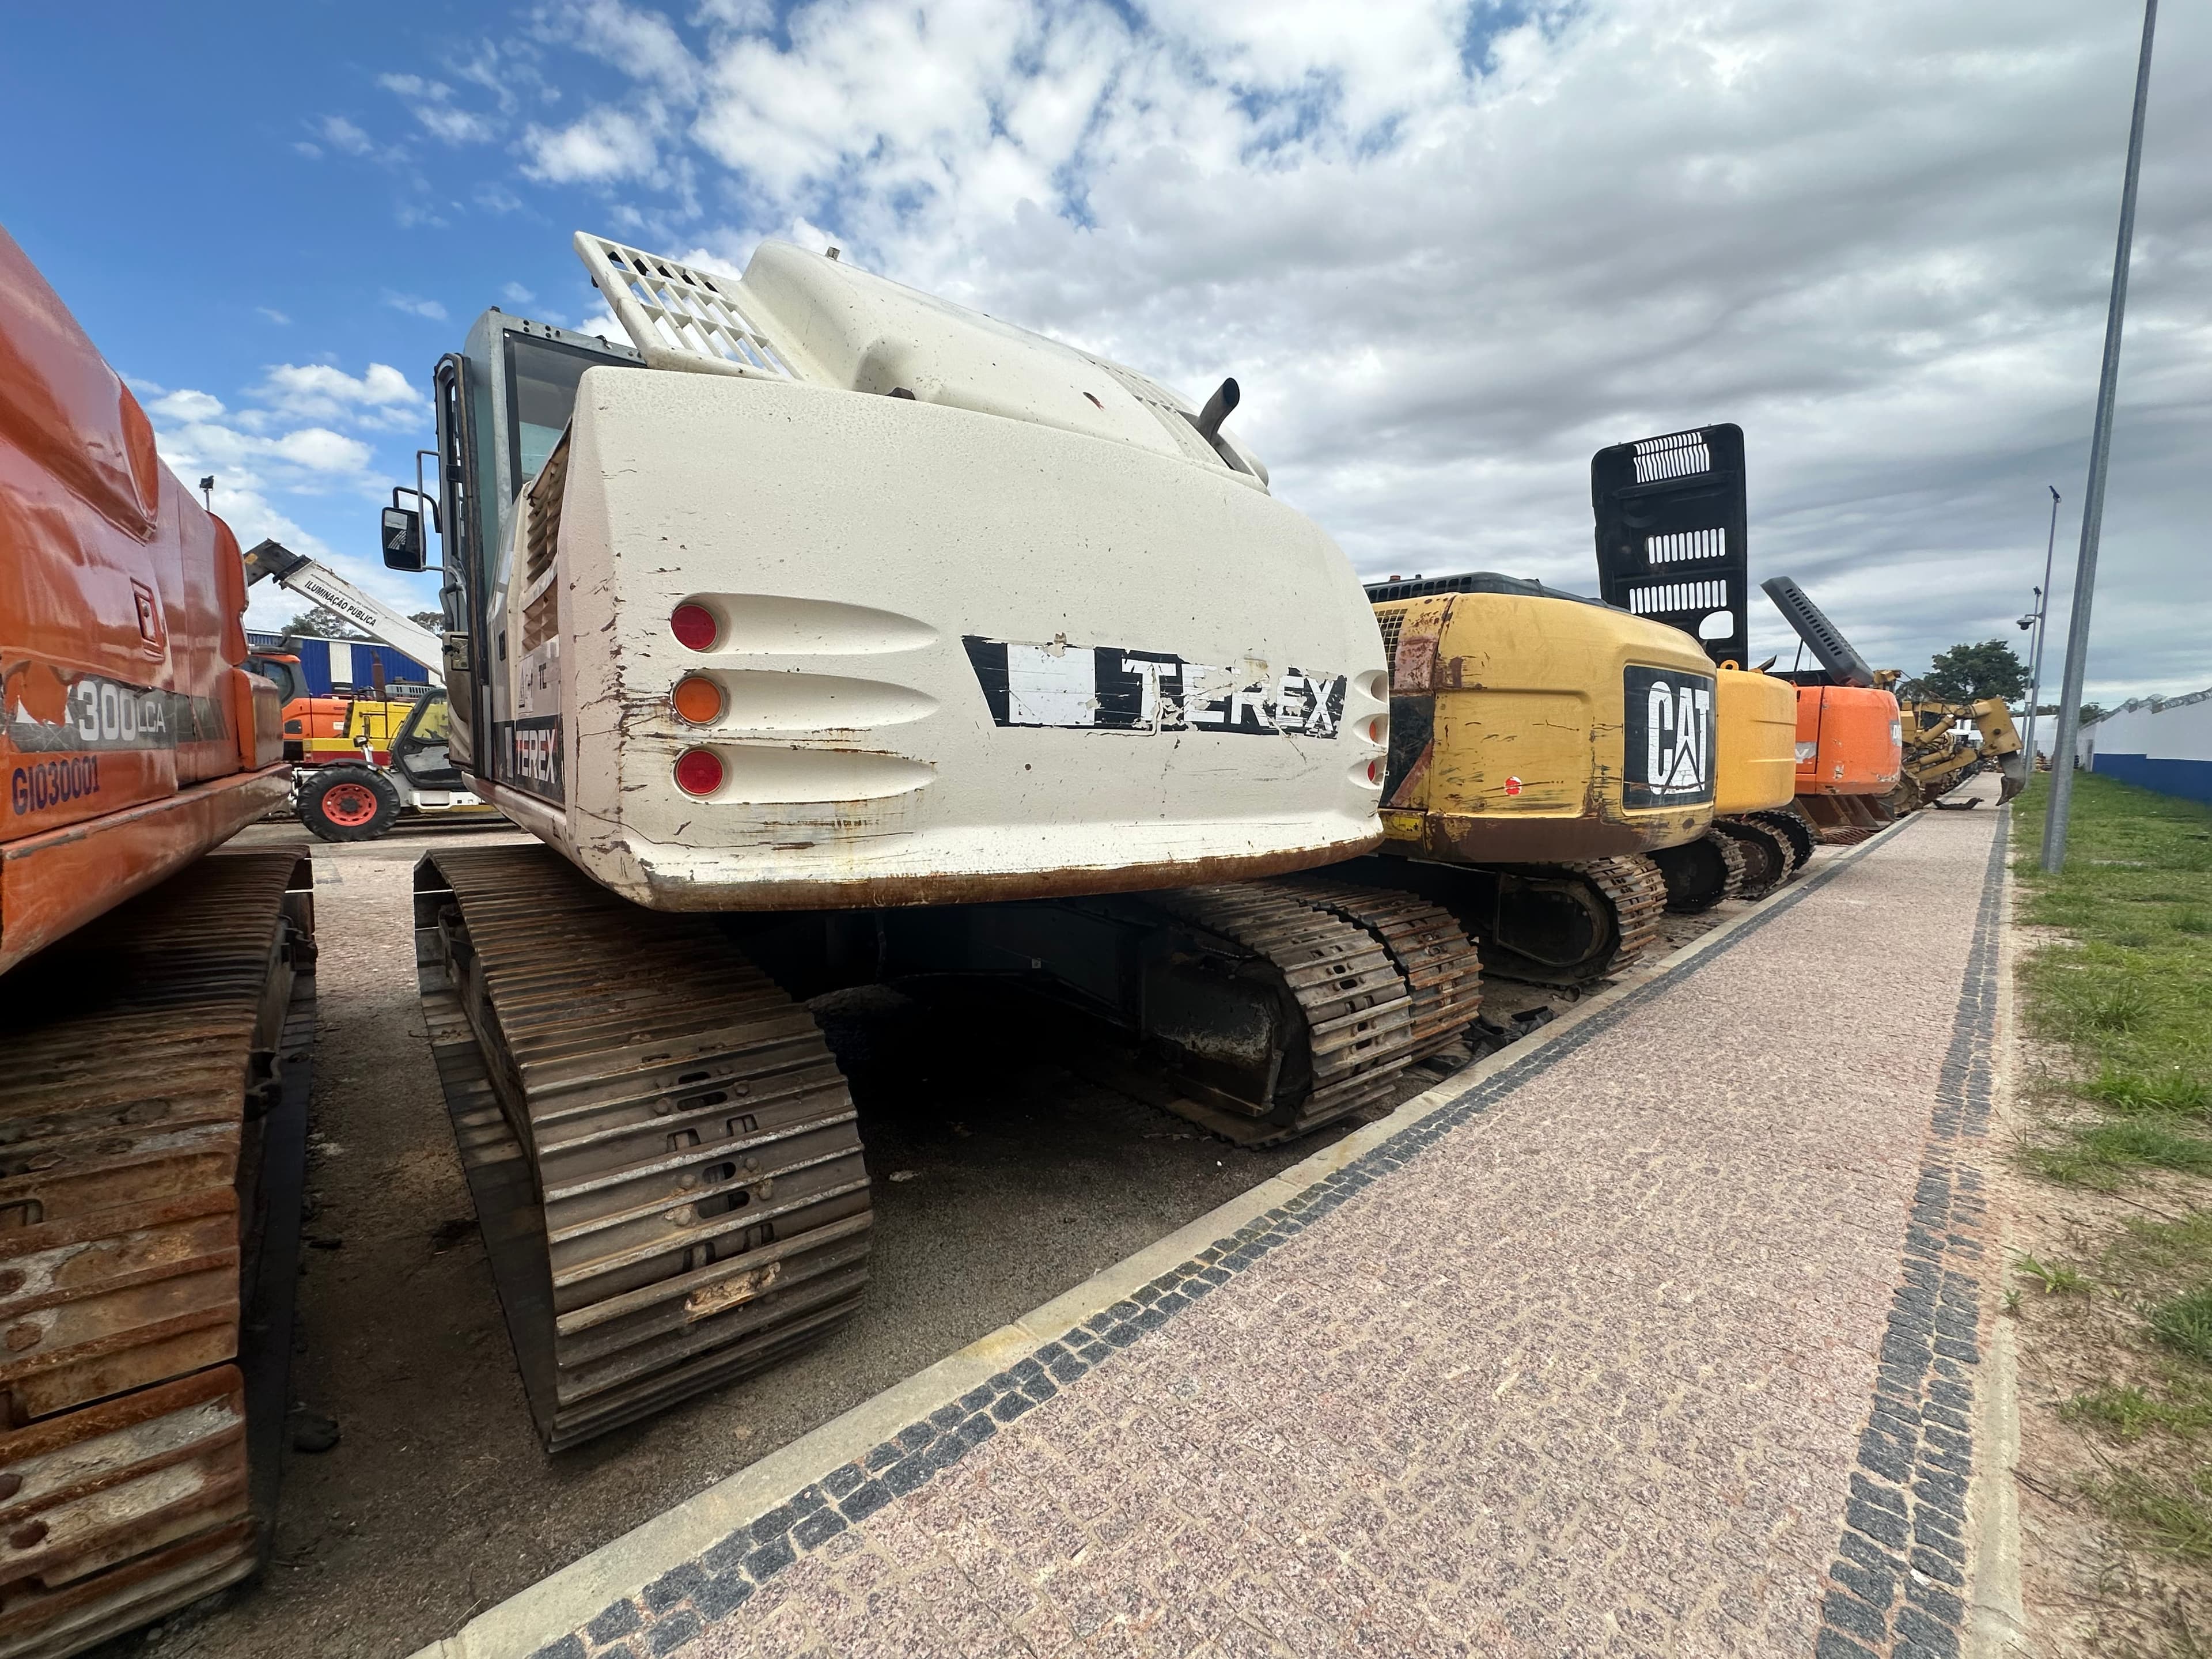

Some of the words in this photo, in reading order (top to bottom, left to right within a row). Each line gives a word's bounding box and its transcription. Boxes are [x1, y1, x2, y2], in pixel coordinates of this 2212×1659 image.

[304, 581, 349, 609] ILUMINAÇÃO
[1122, 658, 1335, 732] TEREX
[516, 729, 555, 784] TEREX
[1647, 681, 1710, 795] CAT
